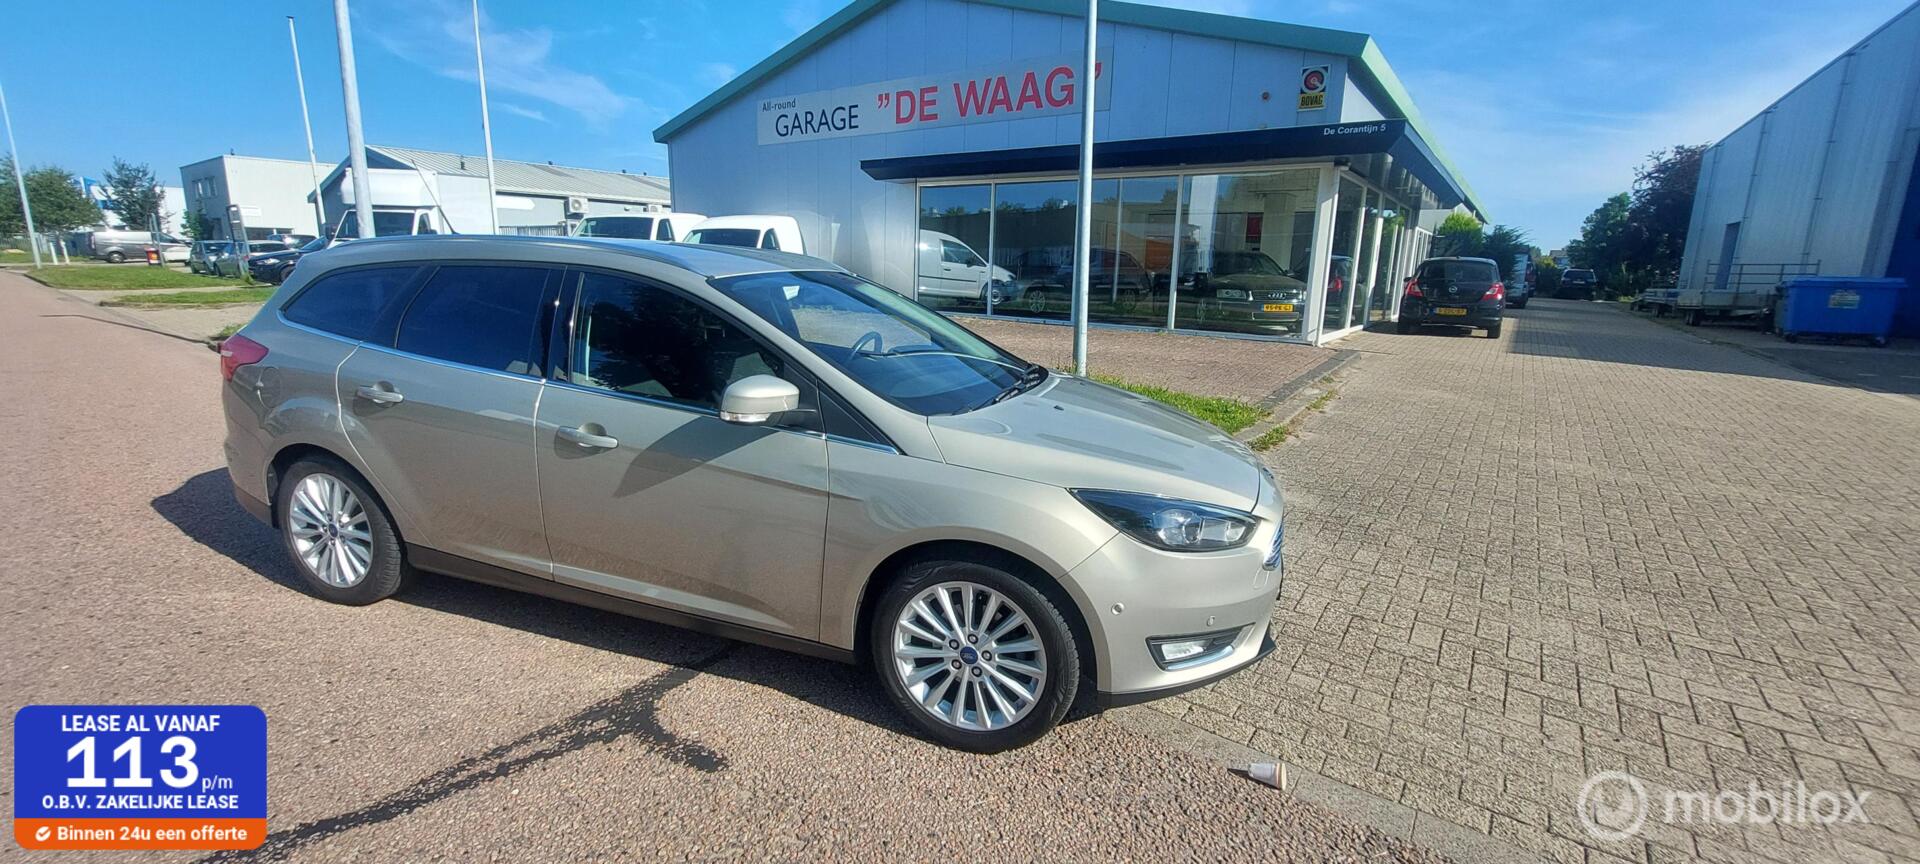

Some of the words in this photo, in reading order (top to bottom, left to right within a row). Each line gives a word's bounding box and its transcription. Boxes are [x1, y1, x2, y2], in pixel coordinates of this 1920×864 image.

[762, 99, 796, 113] All-round
[1301, 94, 1323, 107] BOVAG
[775, 105, 859, 137] GARAGE
[1324, 127, 1335, 135] De
[1337, 124, 1378, 134] Corantijn
[1380, 123, 1386, 131] 5
